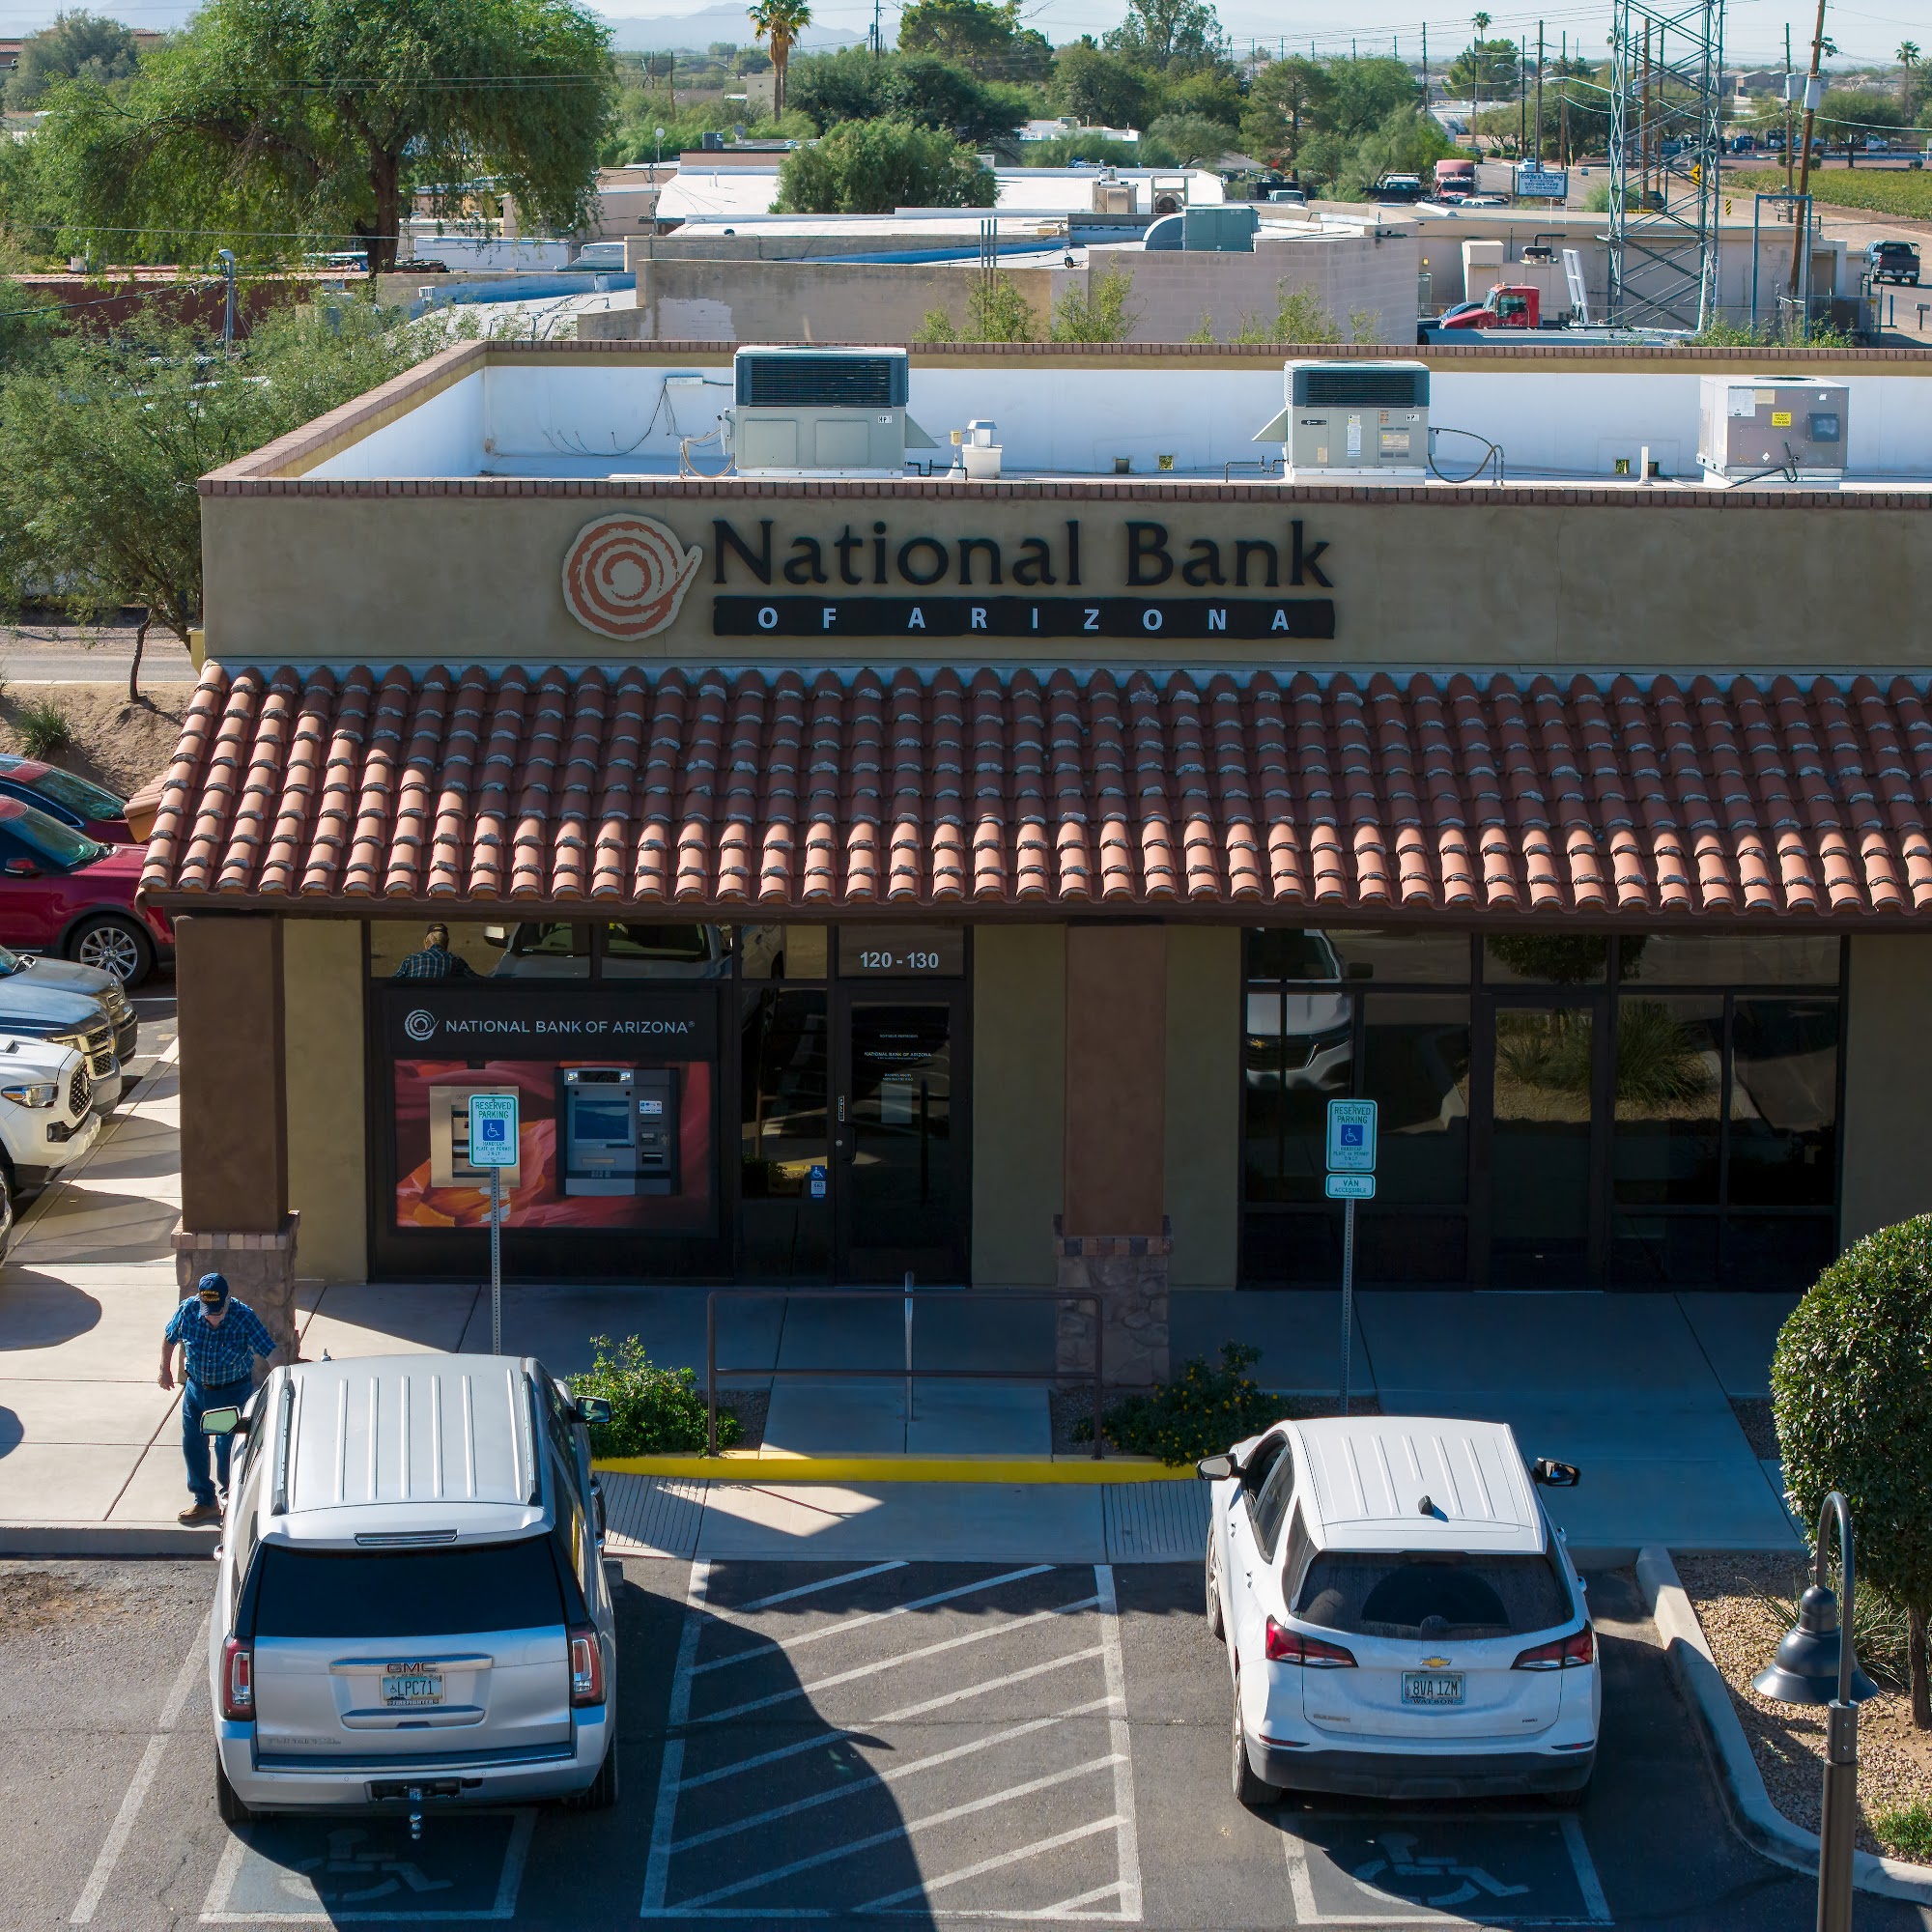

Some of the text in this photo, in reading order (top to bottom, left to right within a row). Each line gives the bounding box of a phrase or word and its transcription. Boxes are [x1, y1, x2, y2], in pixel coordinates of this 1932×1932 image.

[713, 520, 1335, 588] National Bank
[758, 606, 1291, 631] OF ARIZONA
[860, 952, 892, 968] 120
[907, 952, 939, 969] 130
[445, 1020, 530, 1034] NATIONAL
[535, 1020, 582, 1034] BANK
[584, 1020, 610, 1034] OF
[475, 1101, 512, 1110] RESERVED
[1334, 1106, 1371, 1115] RESERVED
[478, 1110, 509, 1119] PARKING
[1337, 1116, 1368, 1124] PARKING
[386, 1662, 438, 1673] GMC
[397, 1680, 434, 1696] LPC71
[1412, 1680, 1434, 1696] 8VA
